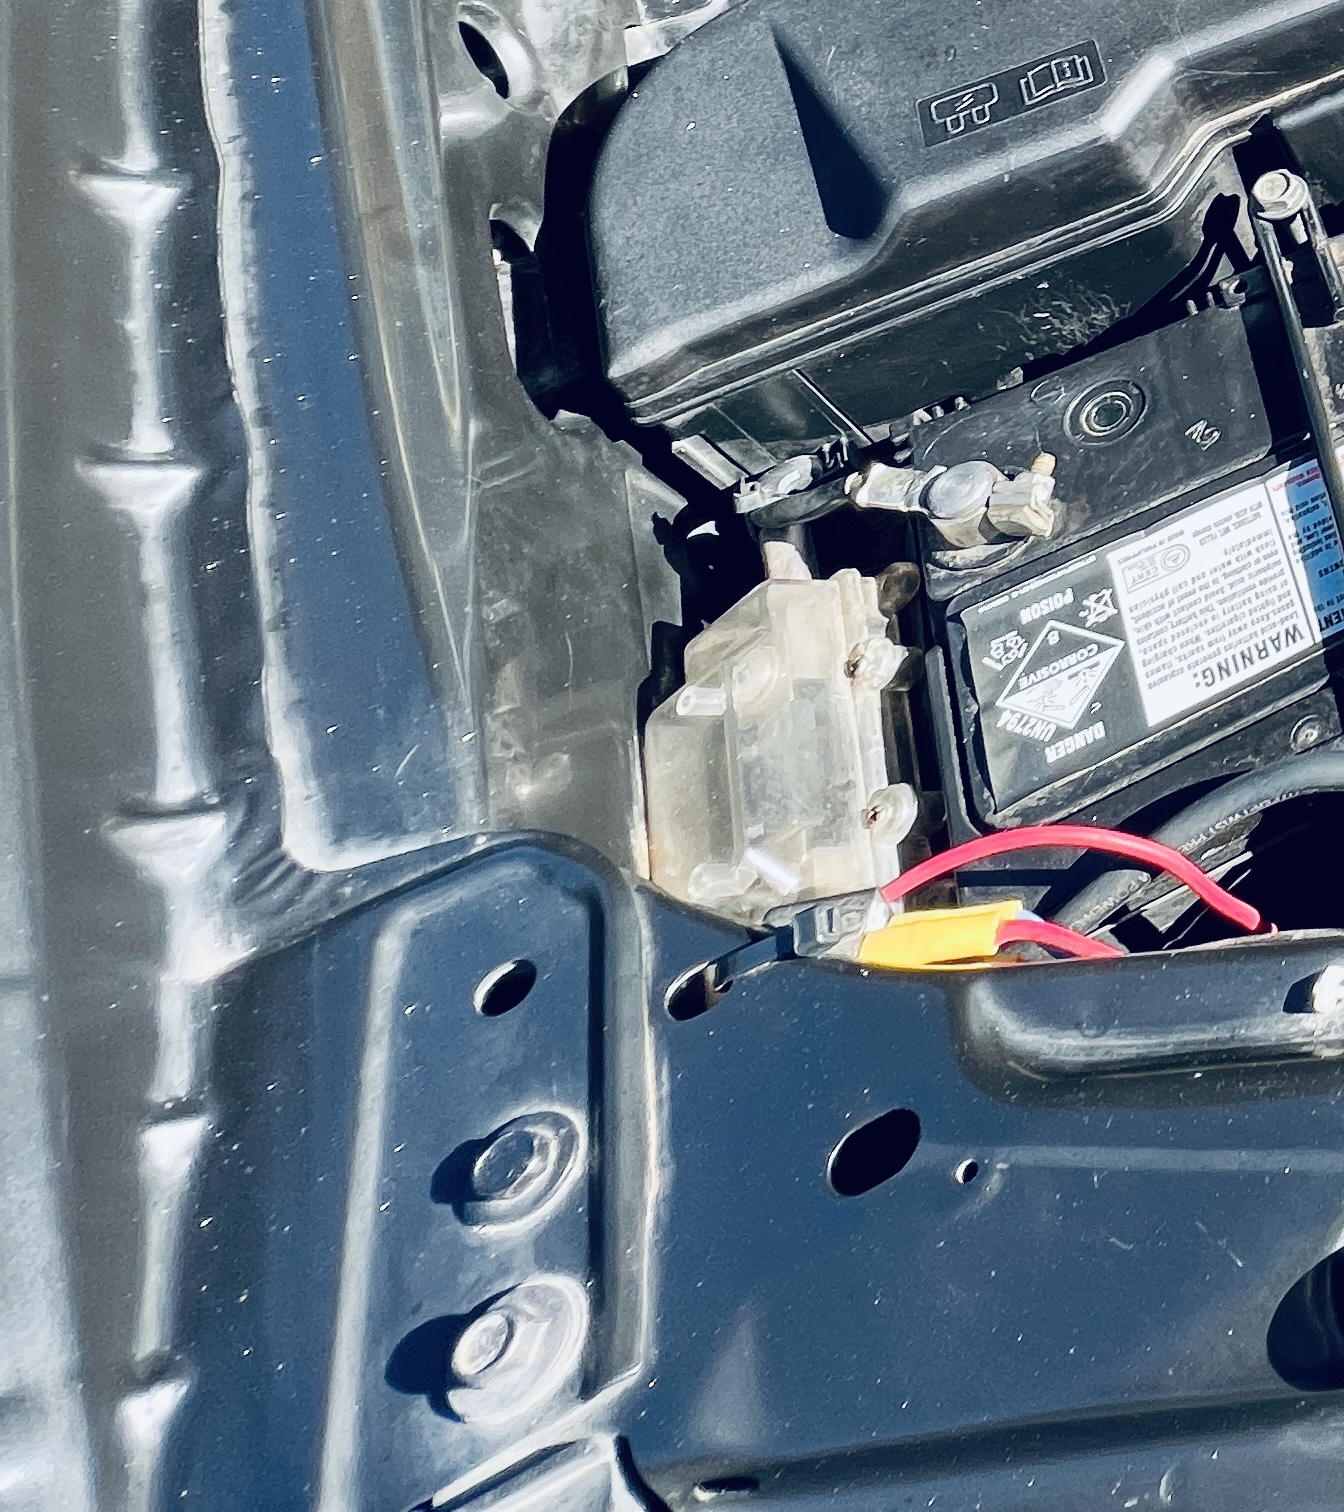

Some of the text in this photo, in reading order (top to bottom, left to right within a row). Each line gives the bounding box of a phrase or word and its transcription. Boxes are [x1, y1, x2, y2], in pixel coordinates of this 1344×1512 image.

[1254, 538, 1276, 554] flush
[1234, 549, 1253, 563] with
[1252, 556, 1261, 565] or
[1130, 565, 1158, 584] CERT
[1208, 558, 1232, 576] water
[1171, 579, 1188, 594] call
[1189, 570, 1206, 585] and
[1197, 580, 1210, 592] the
[1278, 578, 1288, 588] or
[1127, 586, 1170, 615] physician
[1253, 582, 1277, 600] using
[1017, 585, 1075, 627] POISON
[1166, 597, 1175, 608] of
[1198, 602, 1215, 618] This
[1221, 594, 1252, 617] battery
[1153, 612, 1171, 626] with
[1045, 628, 1061, 647] 8
[1141, 589, 1292, 669] and lighted cigarettes. When charging
[1169, 617, 1209, 643] enclosed
[1227, 621, 1248, 638] away
[1138, 636, 1168, 657] space,
[1147, 610, 1299, 690] Lead-acid batteries generate explosive
[1206, 633, 1226, 649] from
[1174, 642, 1205, 665] sparks,
[1191, 621, 1305, 693] WARNING:
[1016, 640, 1099, 690] CORROSIVE
[1144, 659, 1173, 679] flames
[995, 711, 1057, 742] UN2794
[1043, 718, 1106, 765] DANGER
